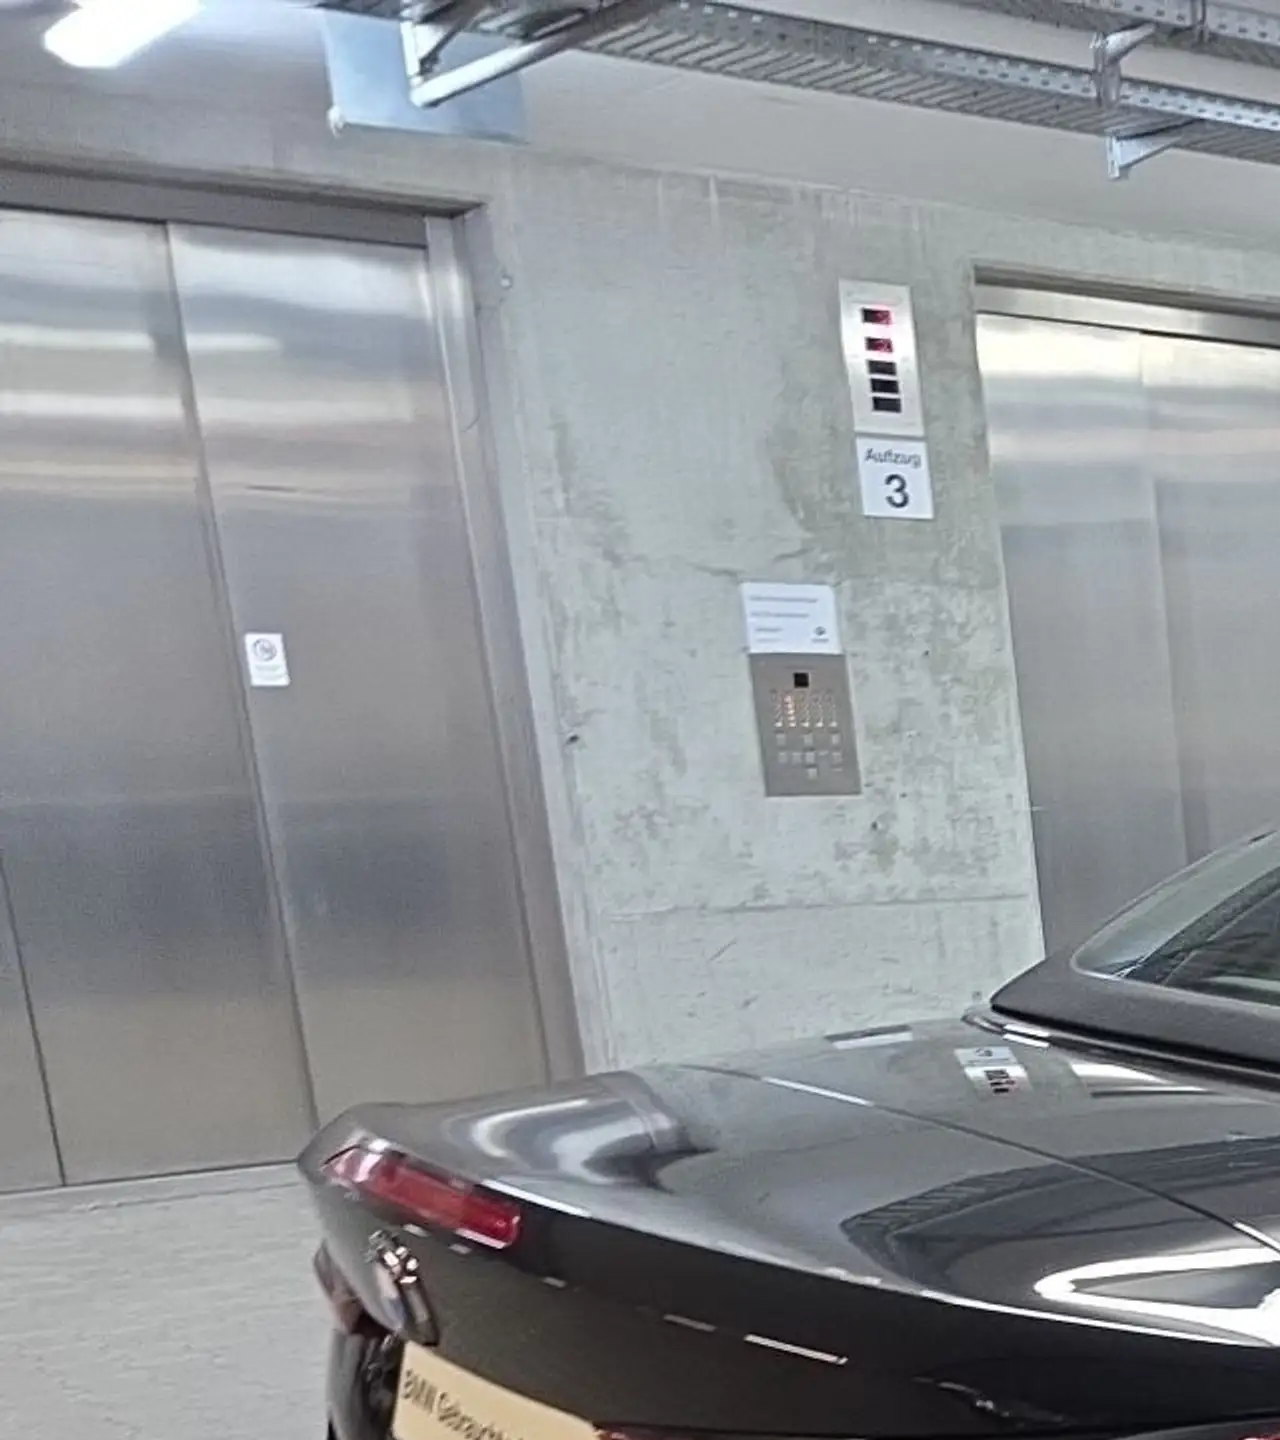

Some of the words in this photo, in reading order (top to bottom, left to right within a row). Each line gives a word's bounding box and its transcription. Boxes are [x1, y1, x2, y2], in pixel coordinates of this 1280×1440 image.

[865, 447, 922, 469] Aufzug
[884, 473, 909, 509] 3
[403, 1368, 439, 1419] BMW
